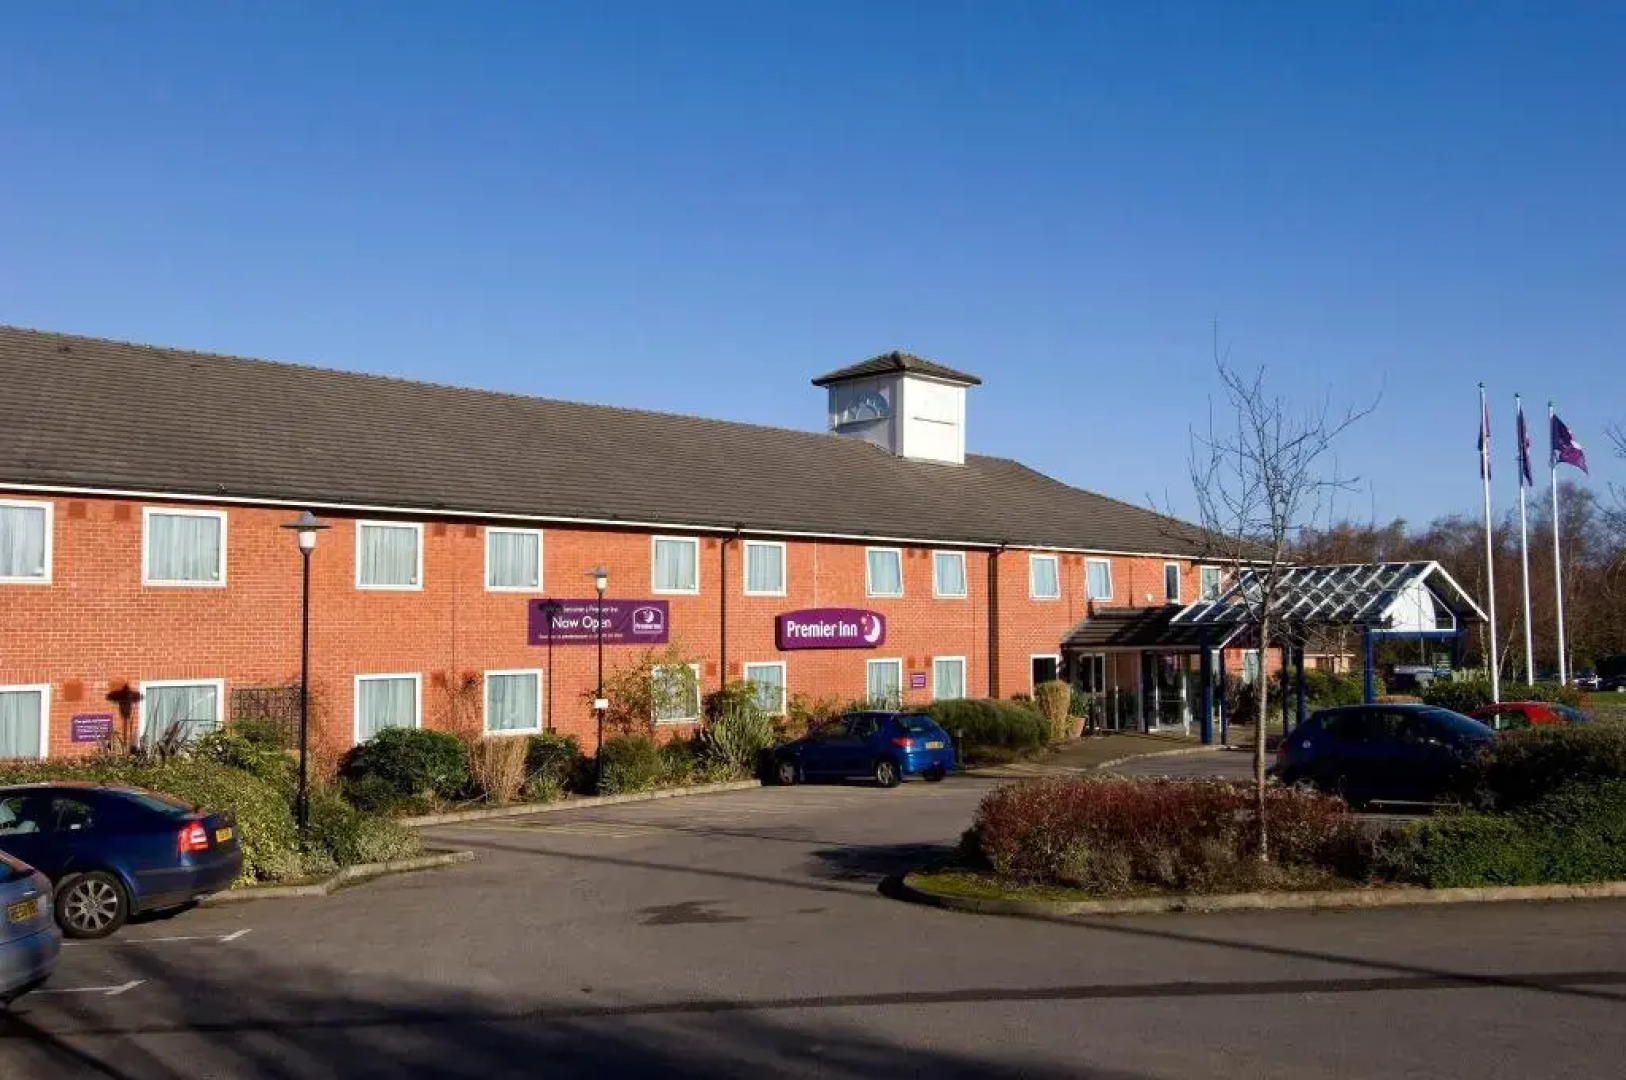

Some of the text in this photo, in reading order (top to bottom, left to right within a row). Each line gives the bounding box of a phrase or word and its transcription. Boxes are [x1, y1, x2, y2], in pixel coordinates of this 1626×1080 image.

[552, 615, 612, 633] Now Open
[787, 620, 858, 638] Premier Inn
